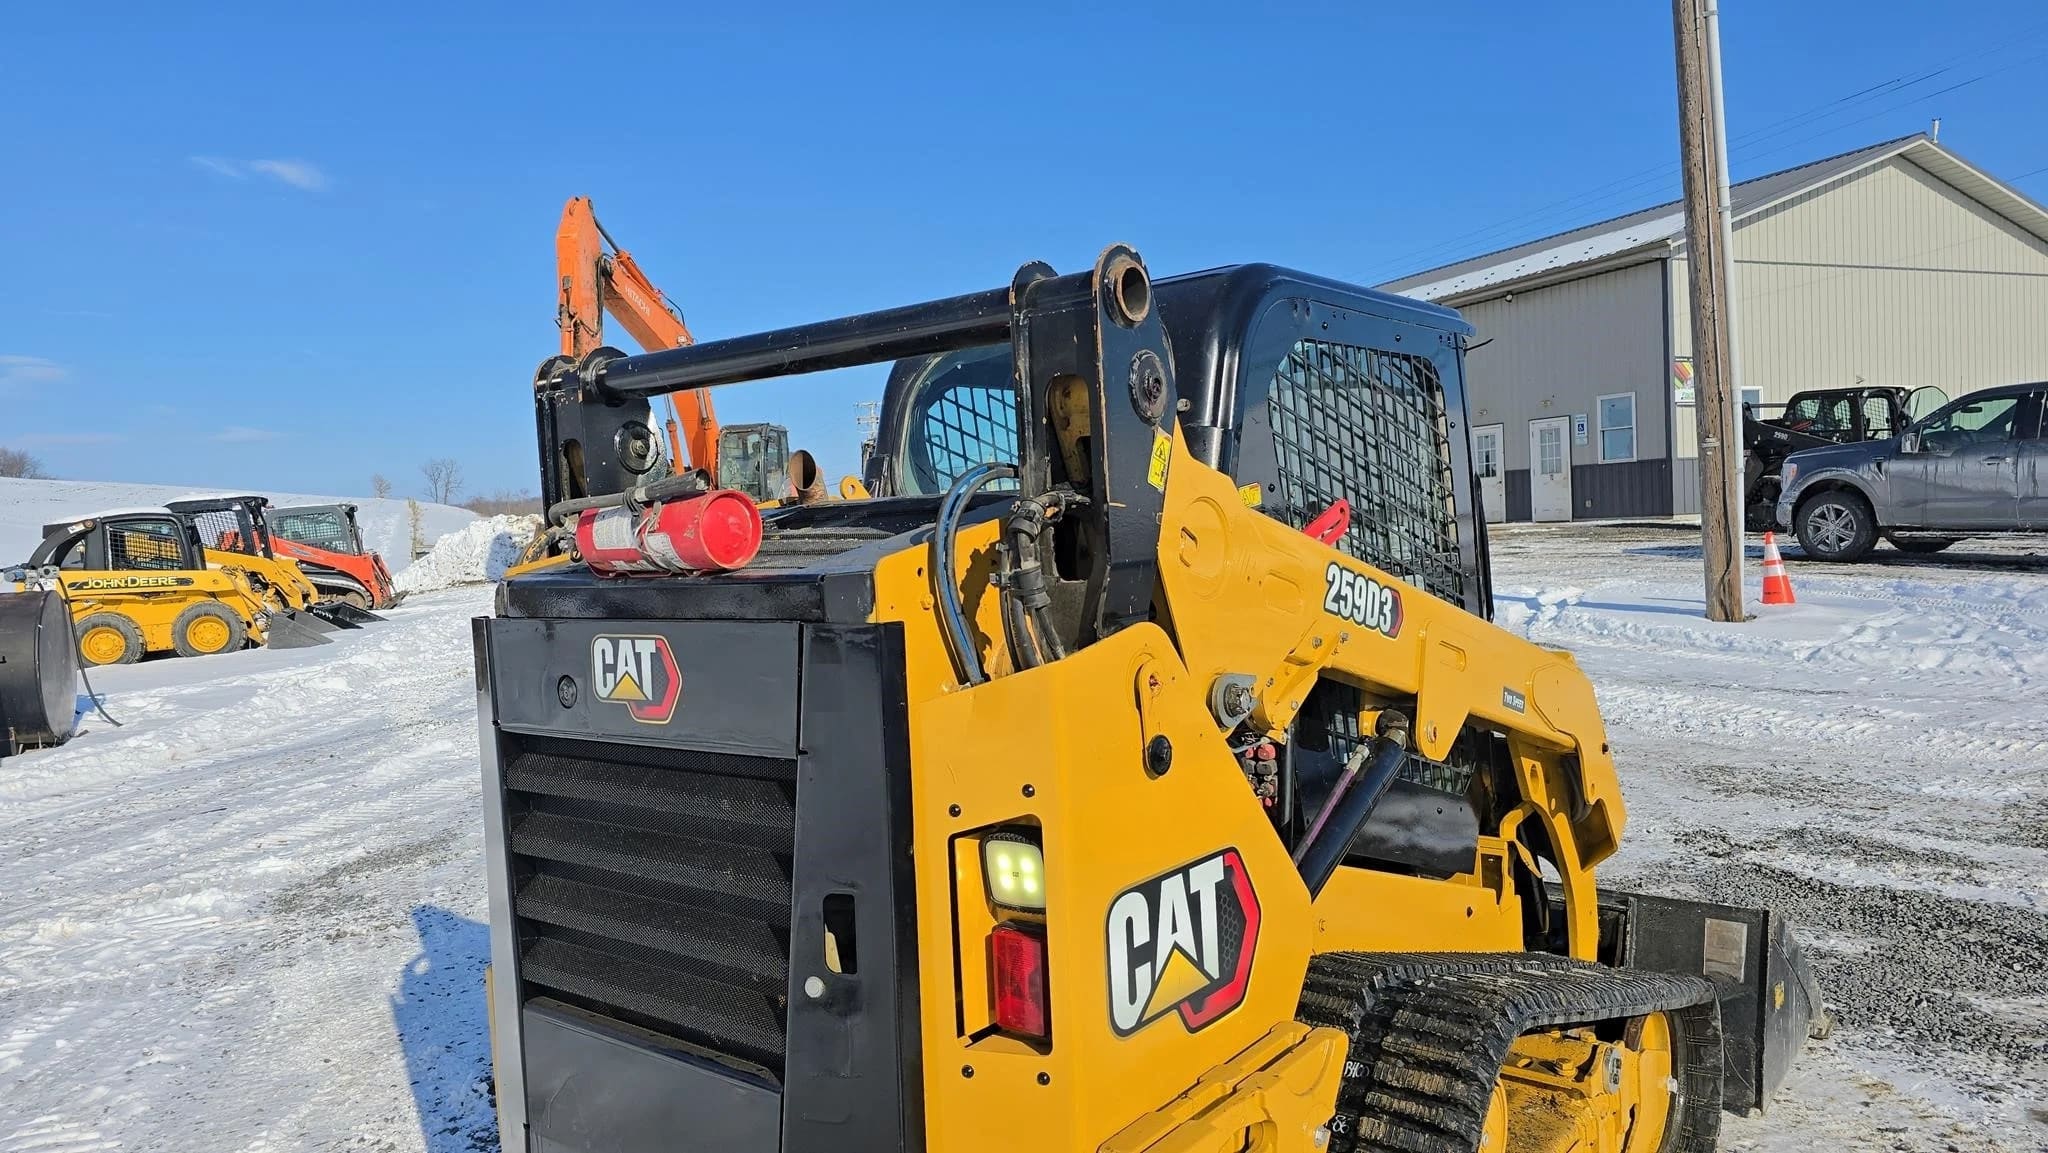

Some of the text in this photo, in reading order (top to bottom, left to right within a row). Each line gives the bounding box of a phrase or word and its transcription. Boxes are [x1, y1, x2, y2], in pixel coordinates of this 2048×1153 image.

[83, 576, 178, 590] JOHN DEERE
[1325, 563, 1393, 633] 259D3
[593, 637, 657, 701] CAT
[1108, 855, 1225, 1031] CAT
